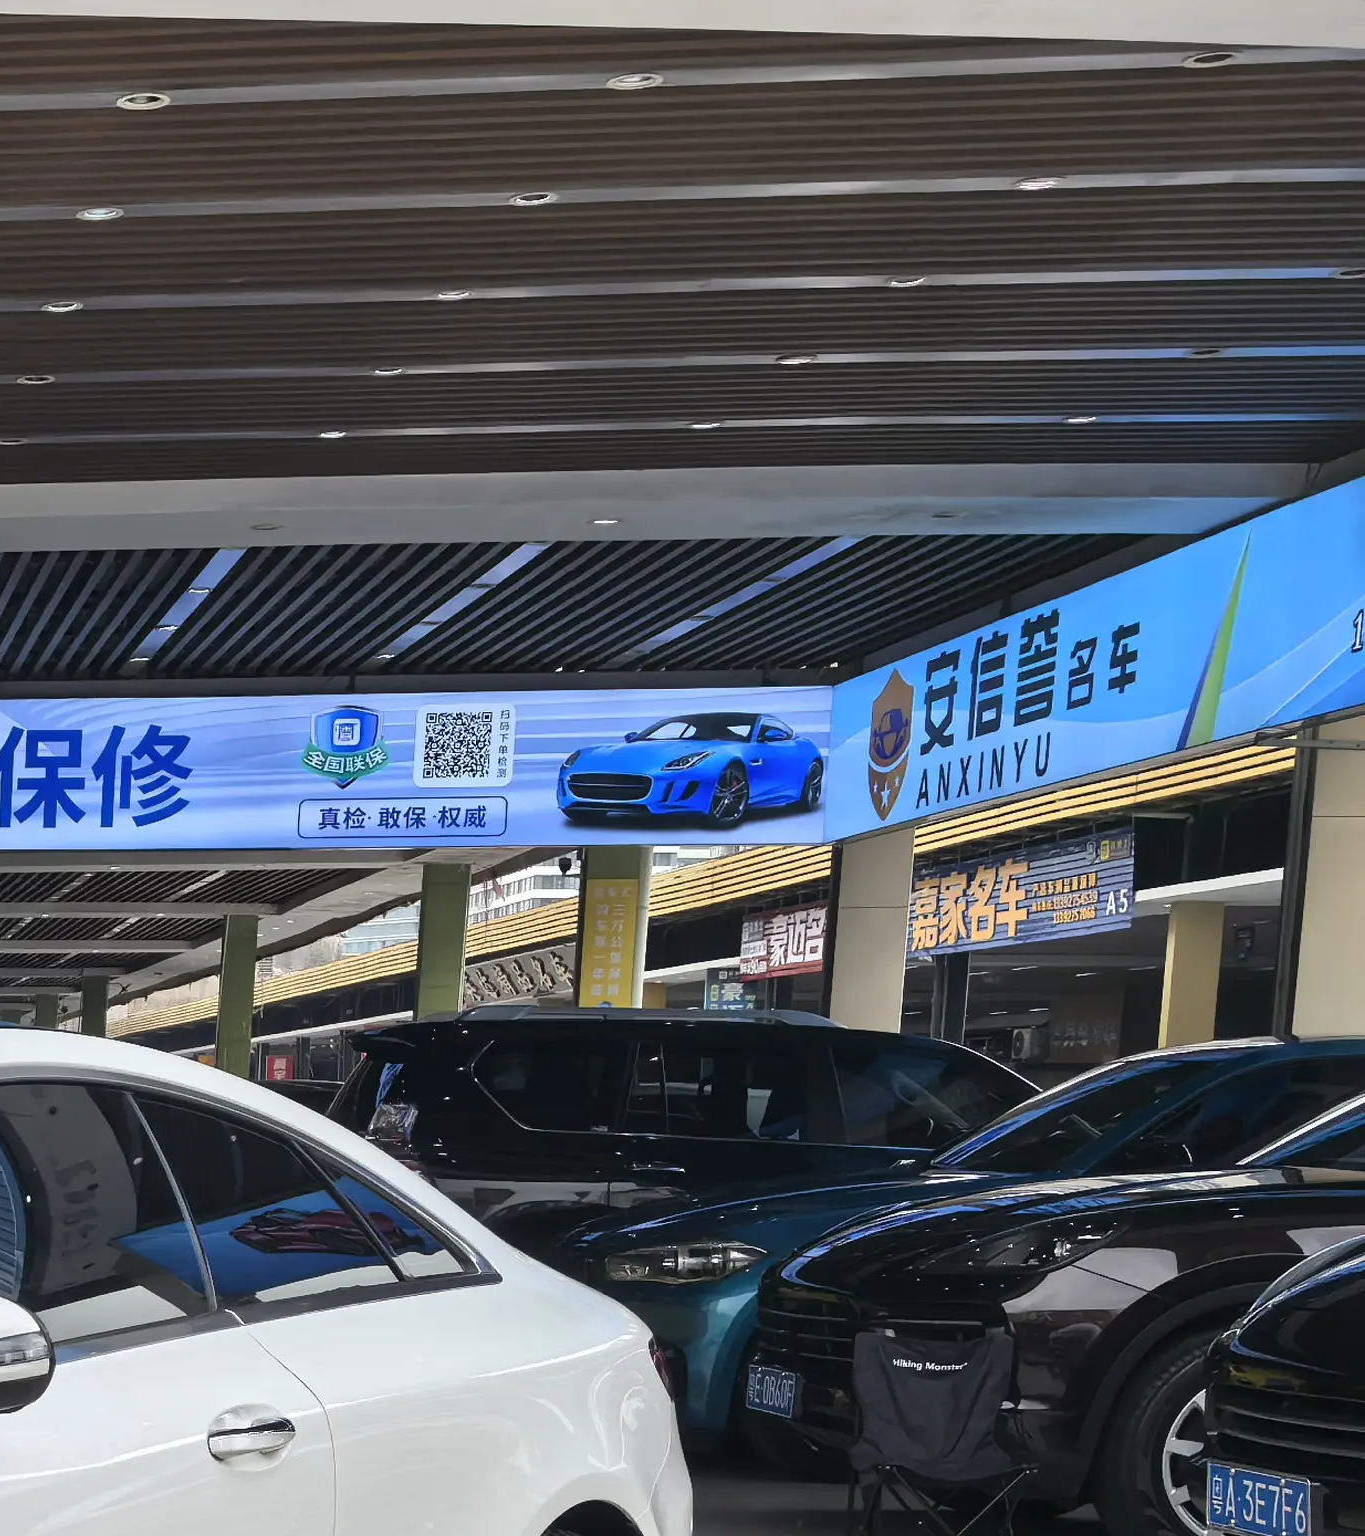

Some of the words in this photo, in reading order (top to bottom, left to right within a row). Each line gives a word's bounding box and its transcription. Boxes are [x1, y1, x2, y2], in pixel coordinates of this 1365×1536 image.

[302, 746, 389, 775] 全国联保
[496, 709, 511, 779] 扫码下单检测
[915, 732, 1052, 811] ANXINYU
[912, 858, 1030, 952] 嘉家名车
[1212, 1473, 1307, 1534] 粤A·3E7F6
